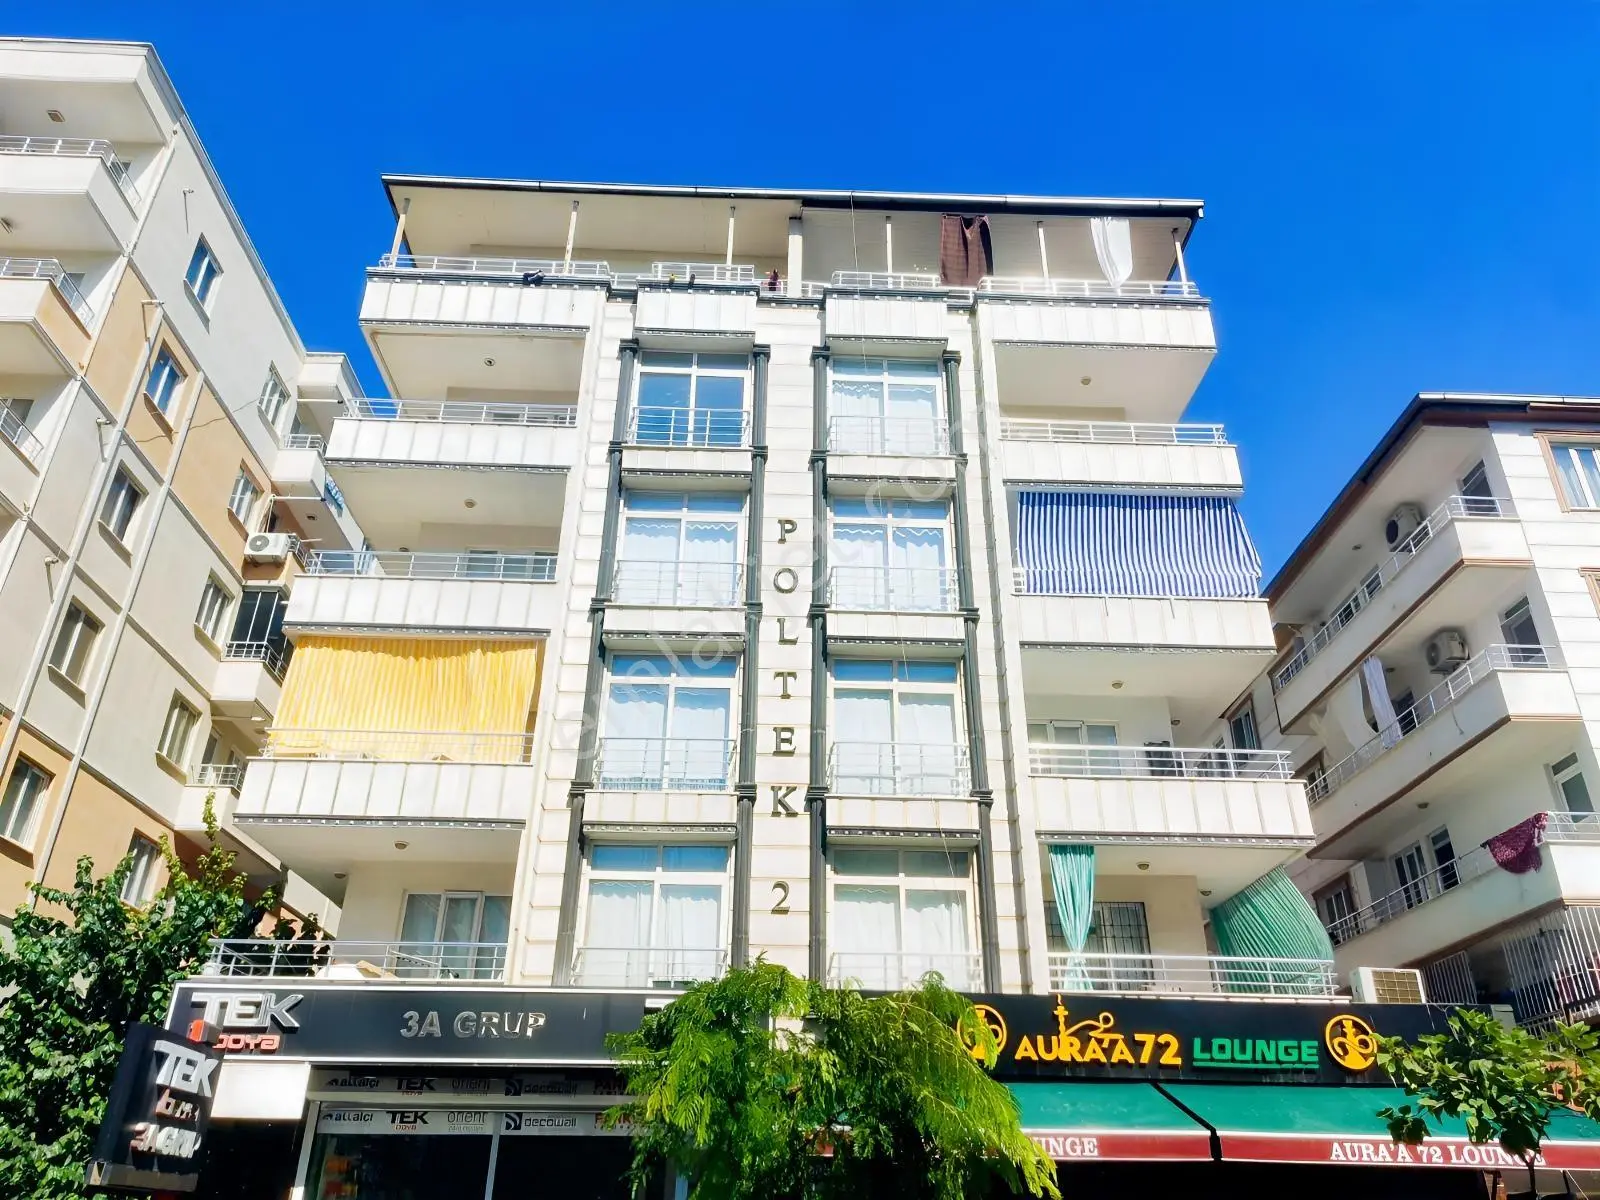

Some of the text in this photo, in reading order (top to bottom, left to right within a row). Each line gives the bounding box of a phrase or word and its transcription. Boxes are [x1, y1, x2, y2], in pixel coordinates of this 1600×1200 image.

[770, 881, 791, 915] 2
[191, 991, 304, 1031] TEK
[400, 1010, 546, 1039] 3A GRUP
[1193, 1037, 1319, 1062] LOUNGE
[153, 1040, 219, 1097] TEK
[396, 1077, 437, 1091] TEK
[386, 1111, 430, 1124] TEK
[524, 1117, 577, 1127] decowall
[1330, 1142, 1414, 1162] AURA'A
[1416, 1146, 1443, 1163] 72
